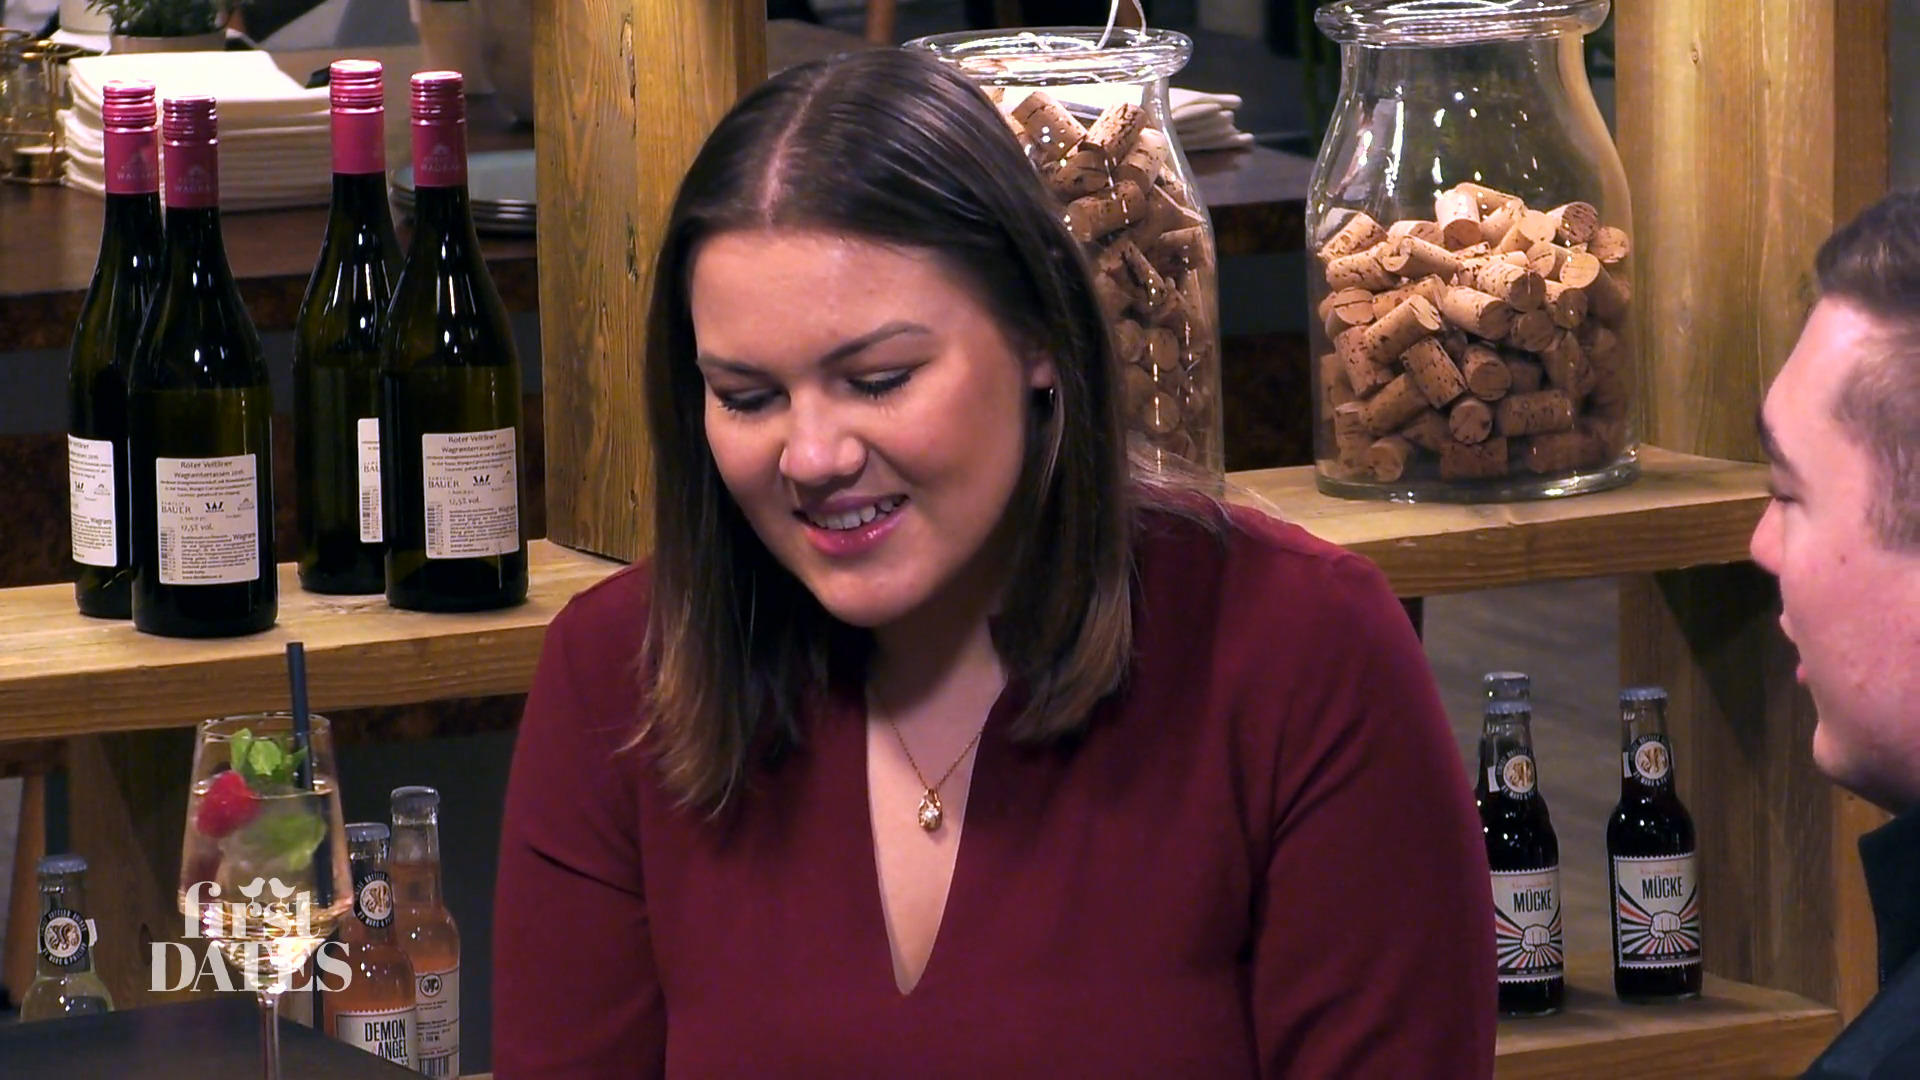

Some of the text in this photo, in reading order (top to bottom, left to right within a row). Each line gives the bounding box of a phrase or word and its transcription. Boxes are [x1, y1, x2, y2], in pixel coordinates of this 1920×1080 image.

[428, 480, 460, 488] BAUER
[161, 505, 192, 514] BAUER
[1641, 876, 1683, 899] MÜCKE
[1513, 888, 1552, 913] MÜCKE
[364, 1018, 406, 1042] DEMON
[377, 1040, 408, 1059] ANGEL
